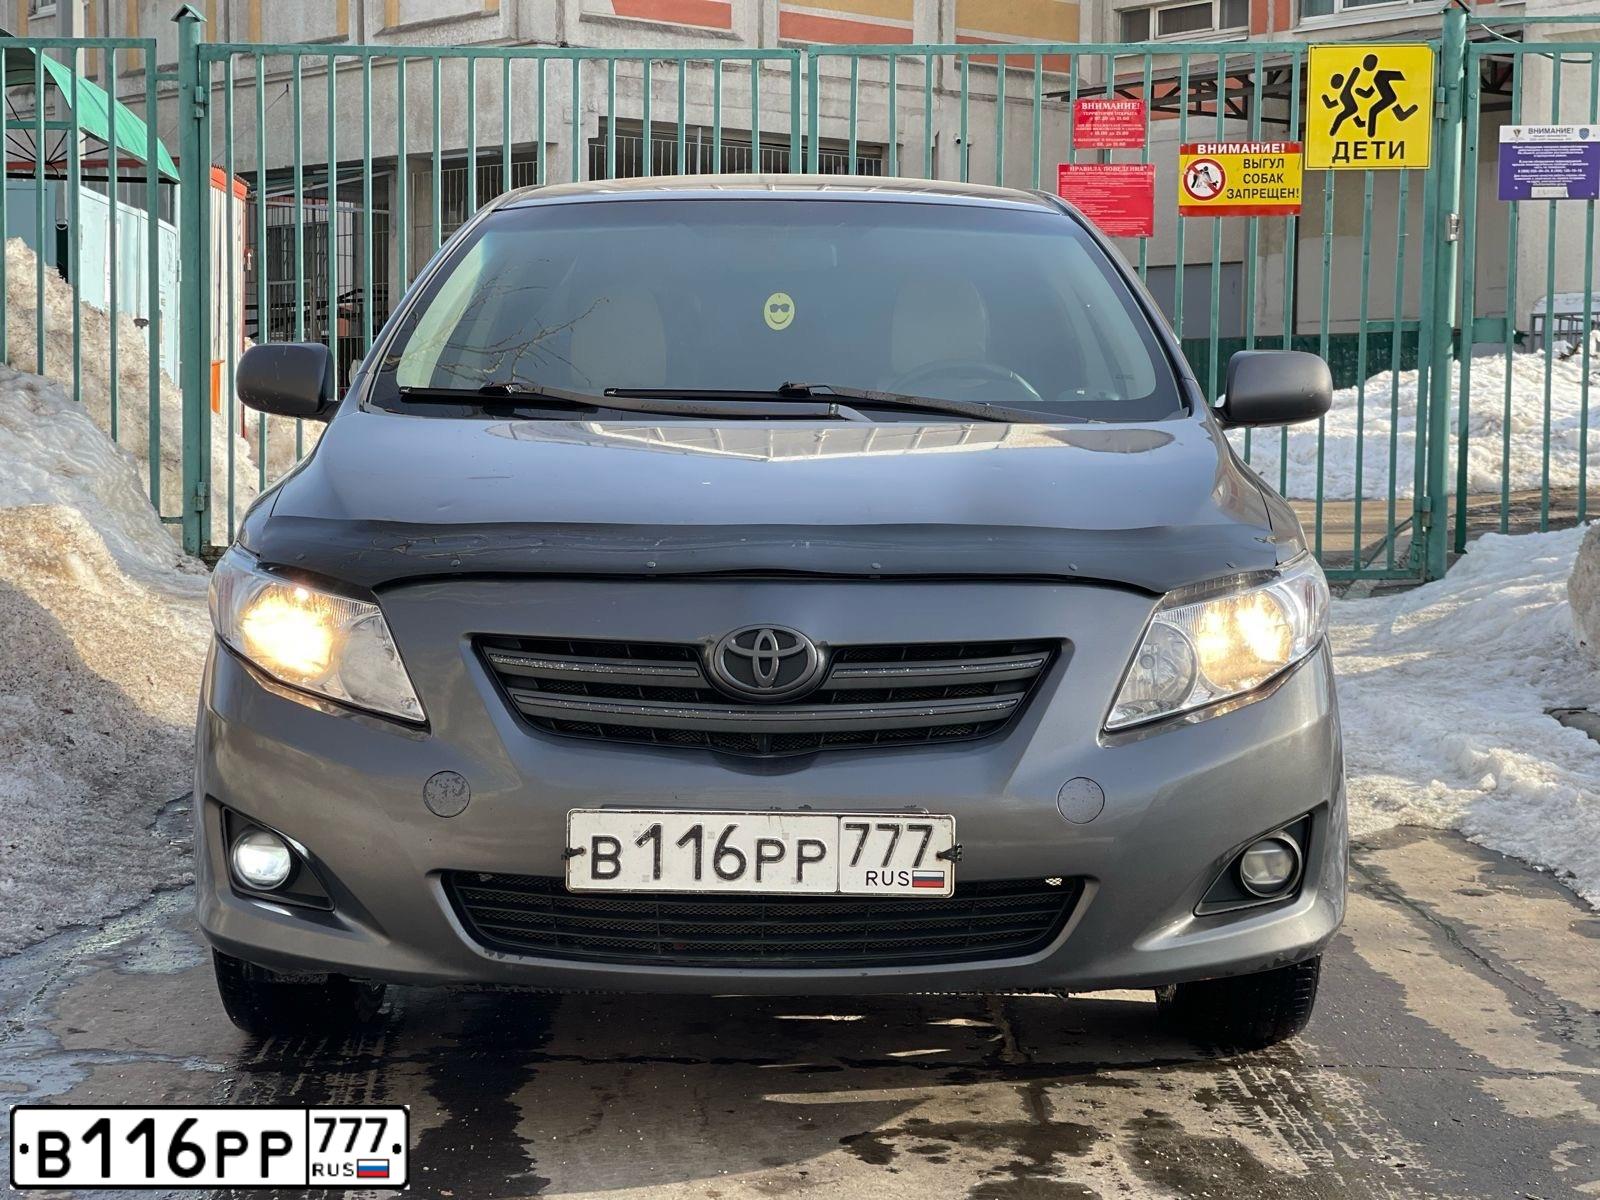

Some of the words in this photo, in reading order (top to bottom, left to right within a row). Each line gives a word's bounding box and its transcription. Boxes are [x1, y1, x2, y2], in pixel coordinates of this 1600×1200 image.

[1081, 102, 1140, 110] ВНИМАНИЕ!
[1528, 127, 1574, 135] ВНИМАНИЕ!
[1197, 143, 1286, 154] ВНИМАНИЕ!
[1331, 140, 1405, 164] ДЕТИ
[1243, 158, 1284, 169] ВЫГУЛ
[1243, 173, 1284, 184] СОБАК
[1226, 188, 1300, 200] ЗАПРЕЩЕН!
[590, 823, 827, 883] В116РР
[845, 823, 933, 868] 777
[865, 870, 910, 886] RUS
